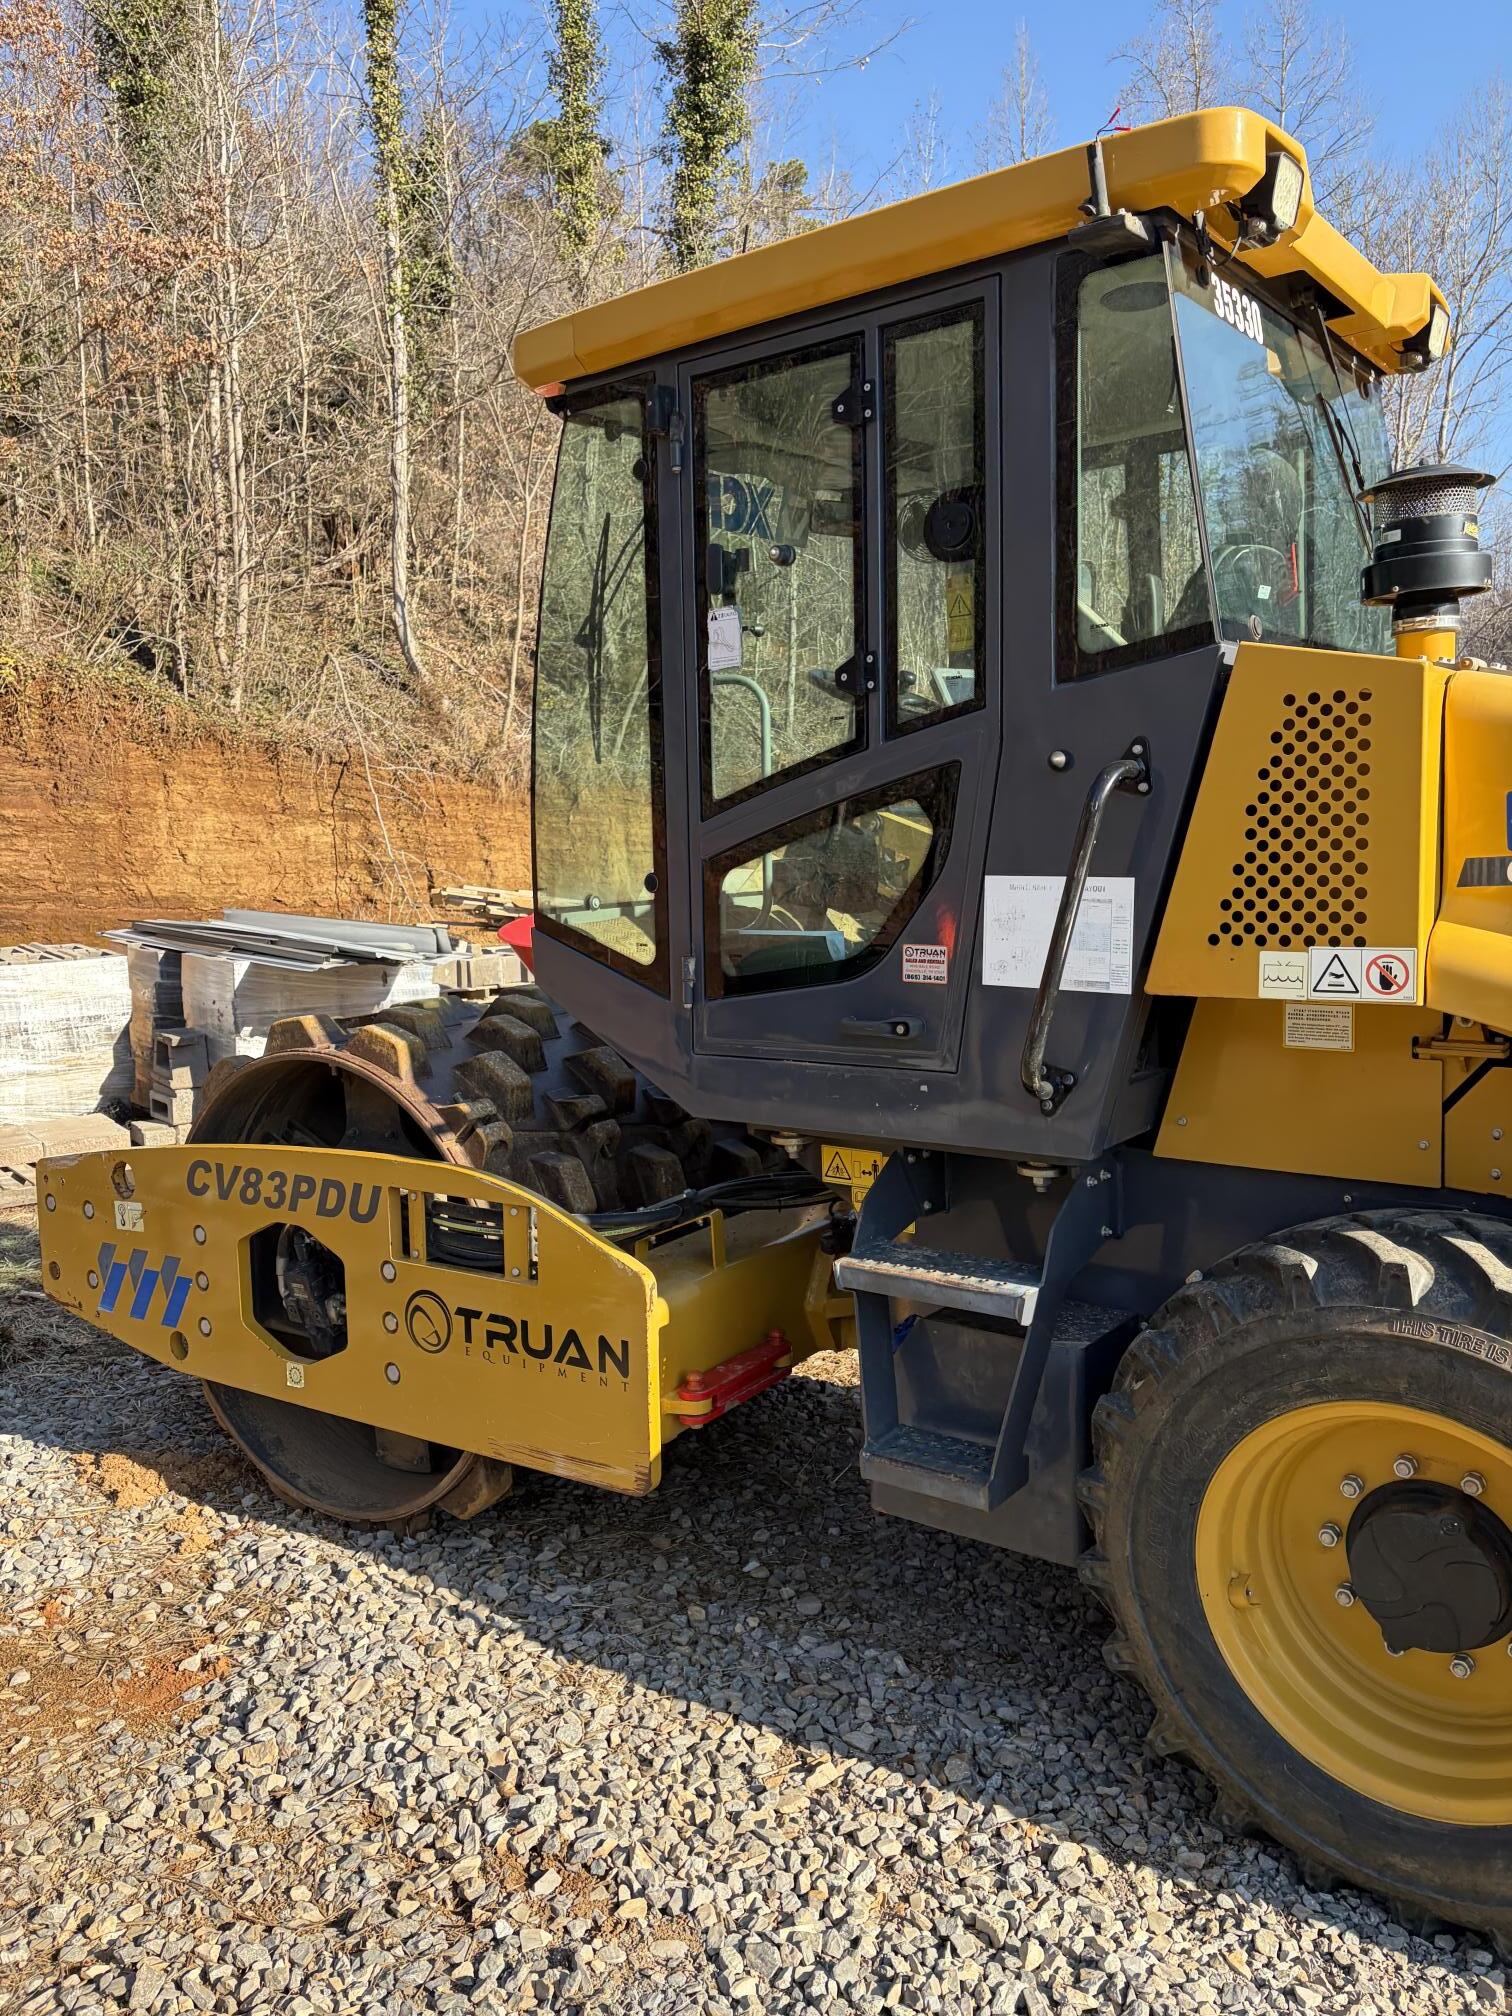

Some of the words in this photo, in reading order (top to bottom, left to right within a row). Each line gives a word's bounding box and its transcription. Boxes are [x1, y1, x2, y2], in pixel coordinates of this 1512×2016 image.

[1210, 271, 1264, 345] 35330
[914, 948, 946, 957] TRUAN
[186, 1159, 382, 1224] CV83PDU
[454, 1306, 630, 1379] TRUAN
[465, 1346, 630, 1393] EQUIPMENT
[1388, 1319, 1436, 1339] THIS
[1439, 1327, 1487, 1356] TIRE
[1486, 1343, 1511, 1365] IS
